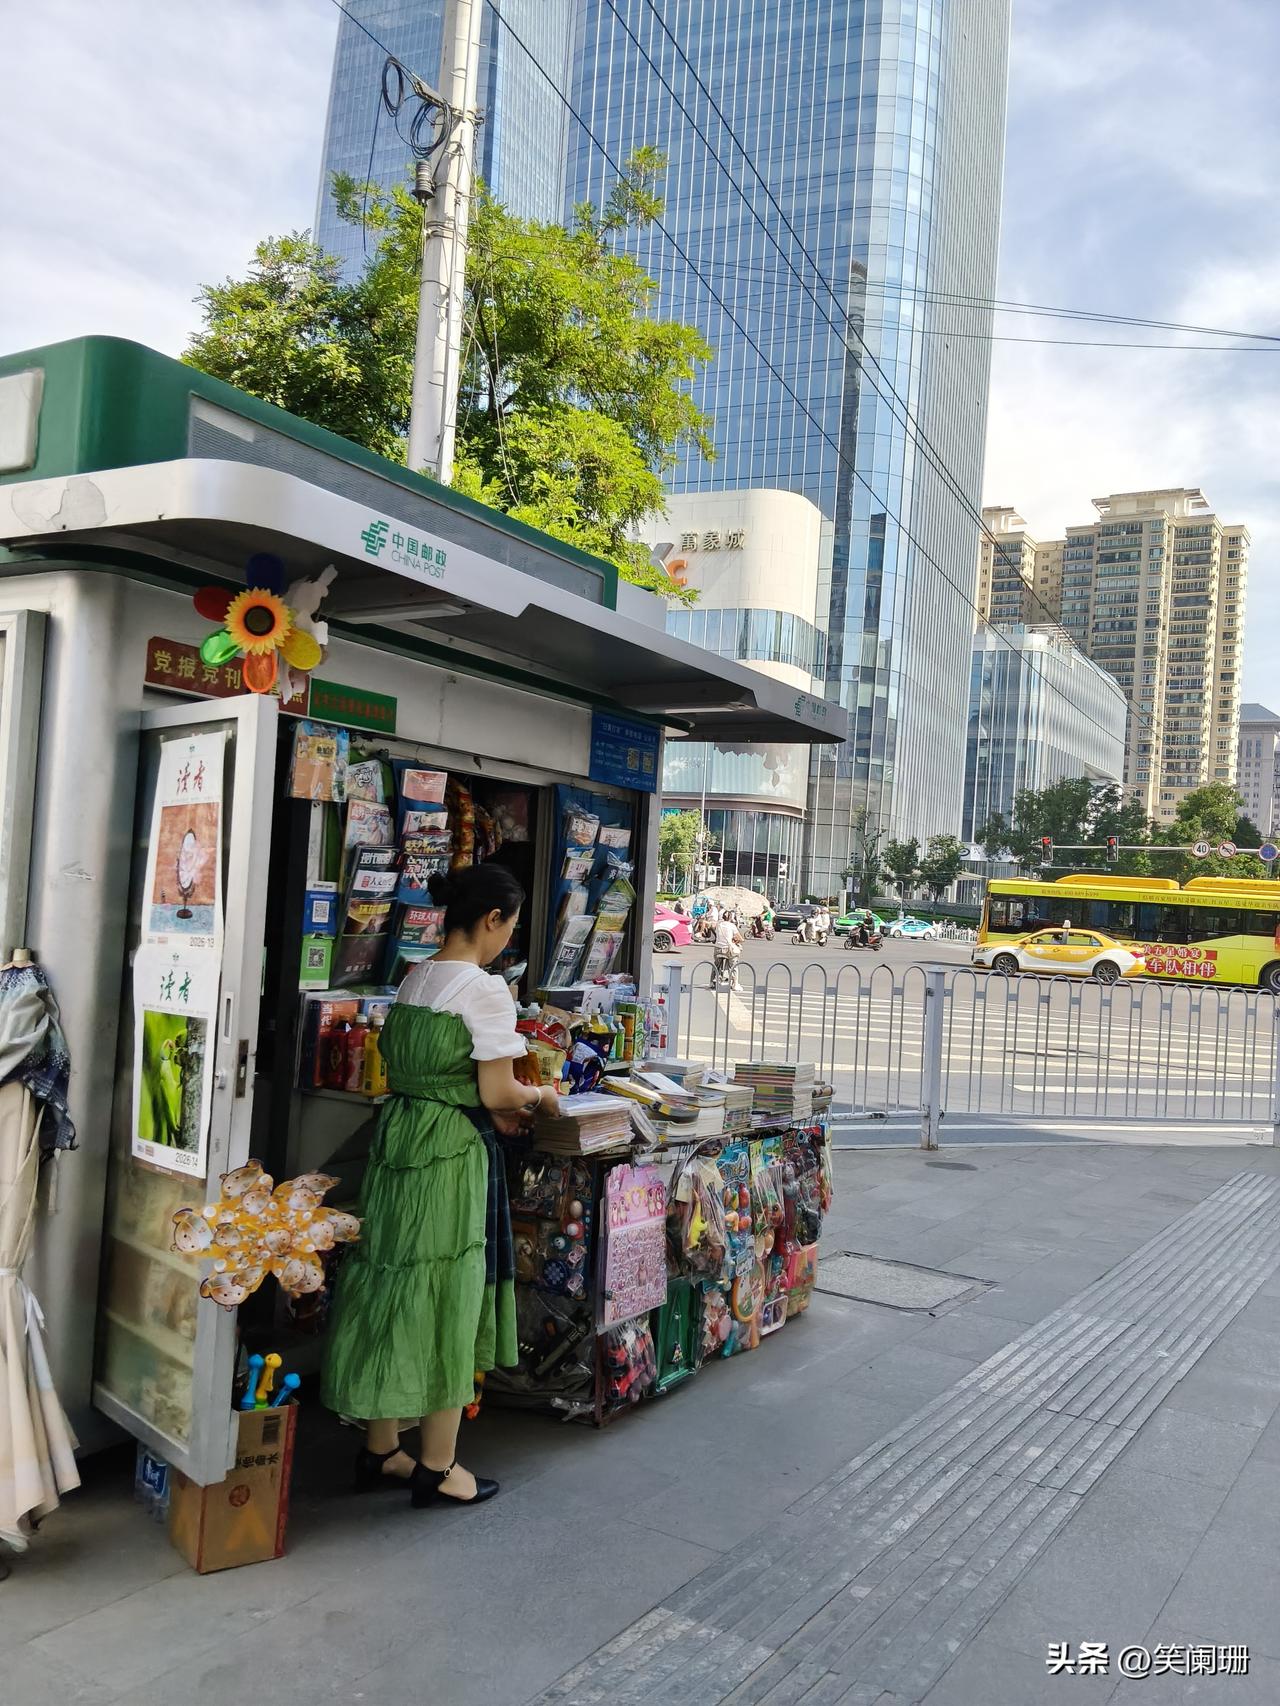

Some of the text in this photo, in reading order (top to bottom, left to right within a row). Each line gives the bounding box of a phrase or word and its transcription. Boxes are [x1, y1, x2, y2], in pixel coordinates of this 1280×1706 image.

[392, 532, 447, 567] 中国邮政
[680, 529, 745, 552] 萬象城
[391, 550, 446, 579] CHINA POST
[154, 650, 241, 689] 党报党刊
[176, 760, 206, 795] 读者
[1196, 845, 1207, 854] 40
[1149, 960, 1215, 977] 车队相伴
[160, 969, 192, 1004] 读者
[321, 1003, 333, 1026] 当代
